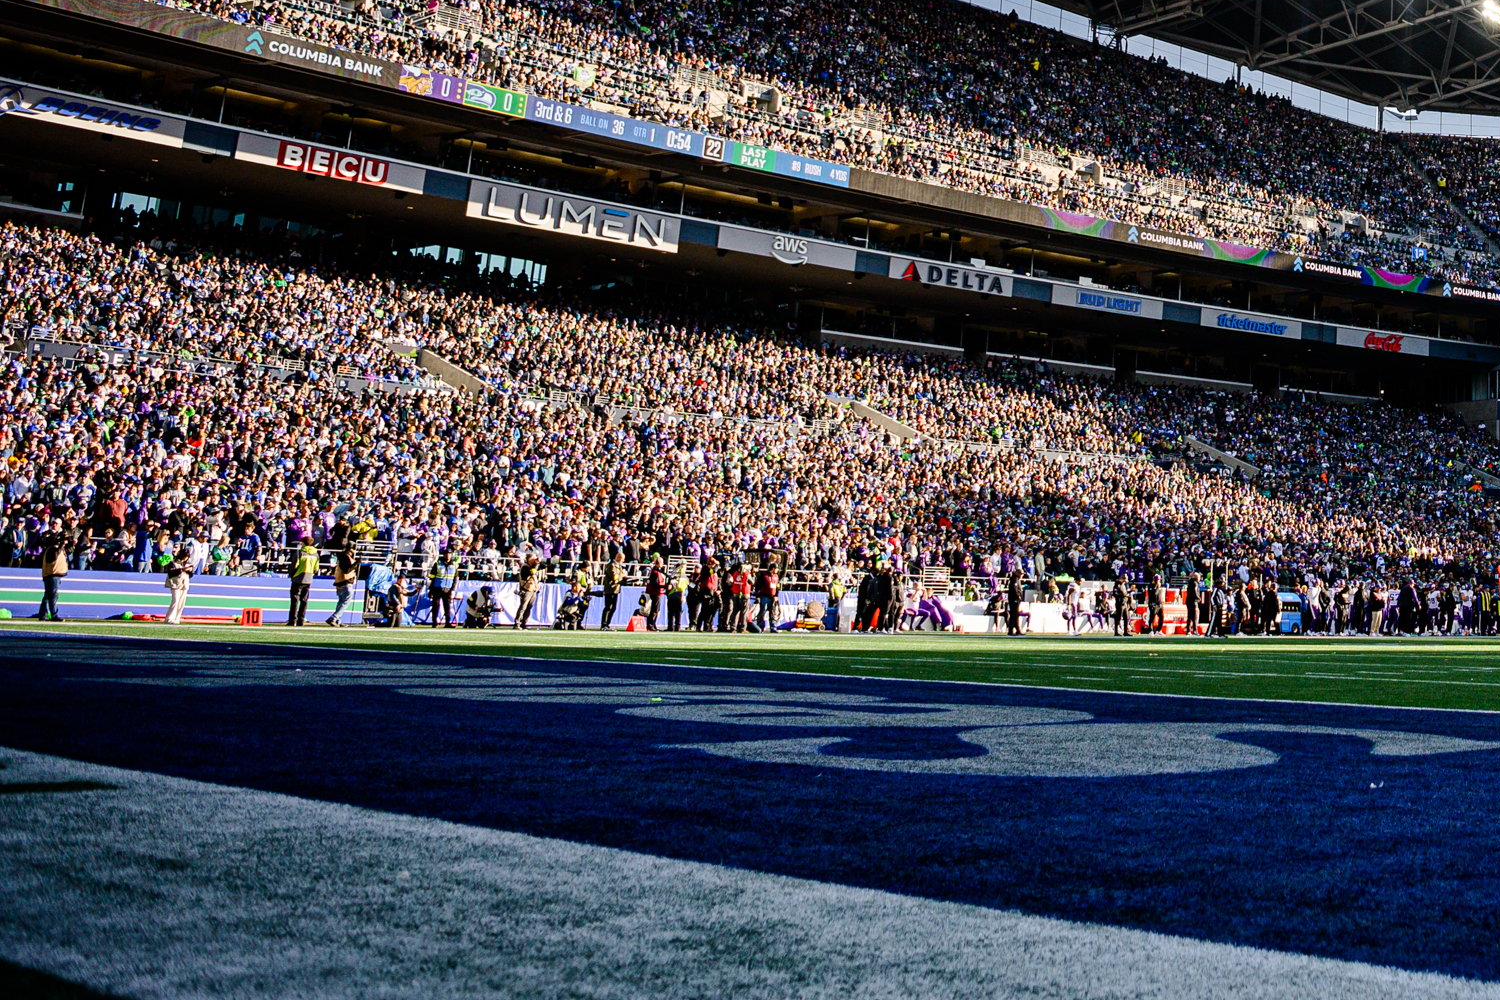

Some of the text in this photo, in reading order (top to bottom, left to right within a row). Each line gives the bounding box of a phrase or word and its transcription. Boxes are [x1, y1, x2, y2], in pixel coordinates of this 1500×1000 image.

[268, 40, 383, 77] COLUMBIA BANK
[441, 78, 451, 97] 0
[503, 93, 513, 111] 0
[535, 101, 553, 119] 3rd
[34, 96, 161, 132] BOEING
[580, 114, 625, 136] BALL ON 36
[634, 126, 656, 142] QTR 1
[666, 130, 692, 151] 0:54
[707, 139, 722, 157] 22
[742, 145, 767, 159] LAST
[283, 145, 385, 183] BECU
[740, 156, 766, 169] PLAY
[804, 163, 822, 177] RUSH
[488, 186, 665, 246] LUMEN
[773, 235, 807, 254] aws
[1140, 231, 1204, 251] COLUMBIA BANK
[1304, 261, 1362, 279] COLUMBIA BANK
[927, 266, 1003, 294] DELTA
[1079, 292, 1142, 312] BUD LIGHT
[1452, 286, 1486, 300] COLUMBIA
[1217, 313, 1287, 335] ticketmaster
[246, 611, 259, 624] 10
[634, 618, 645, 630] 20
